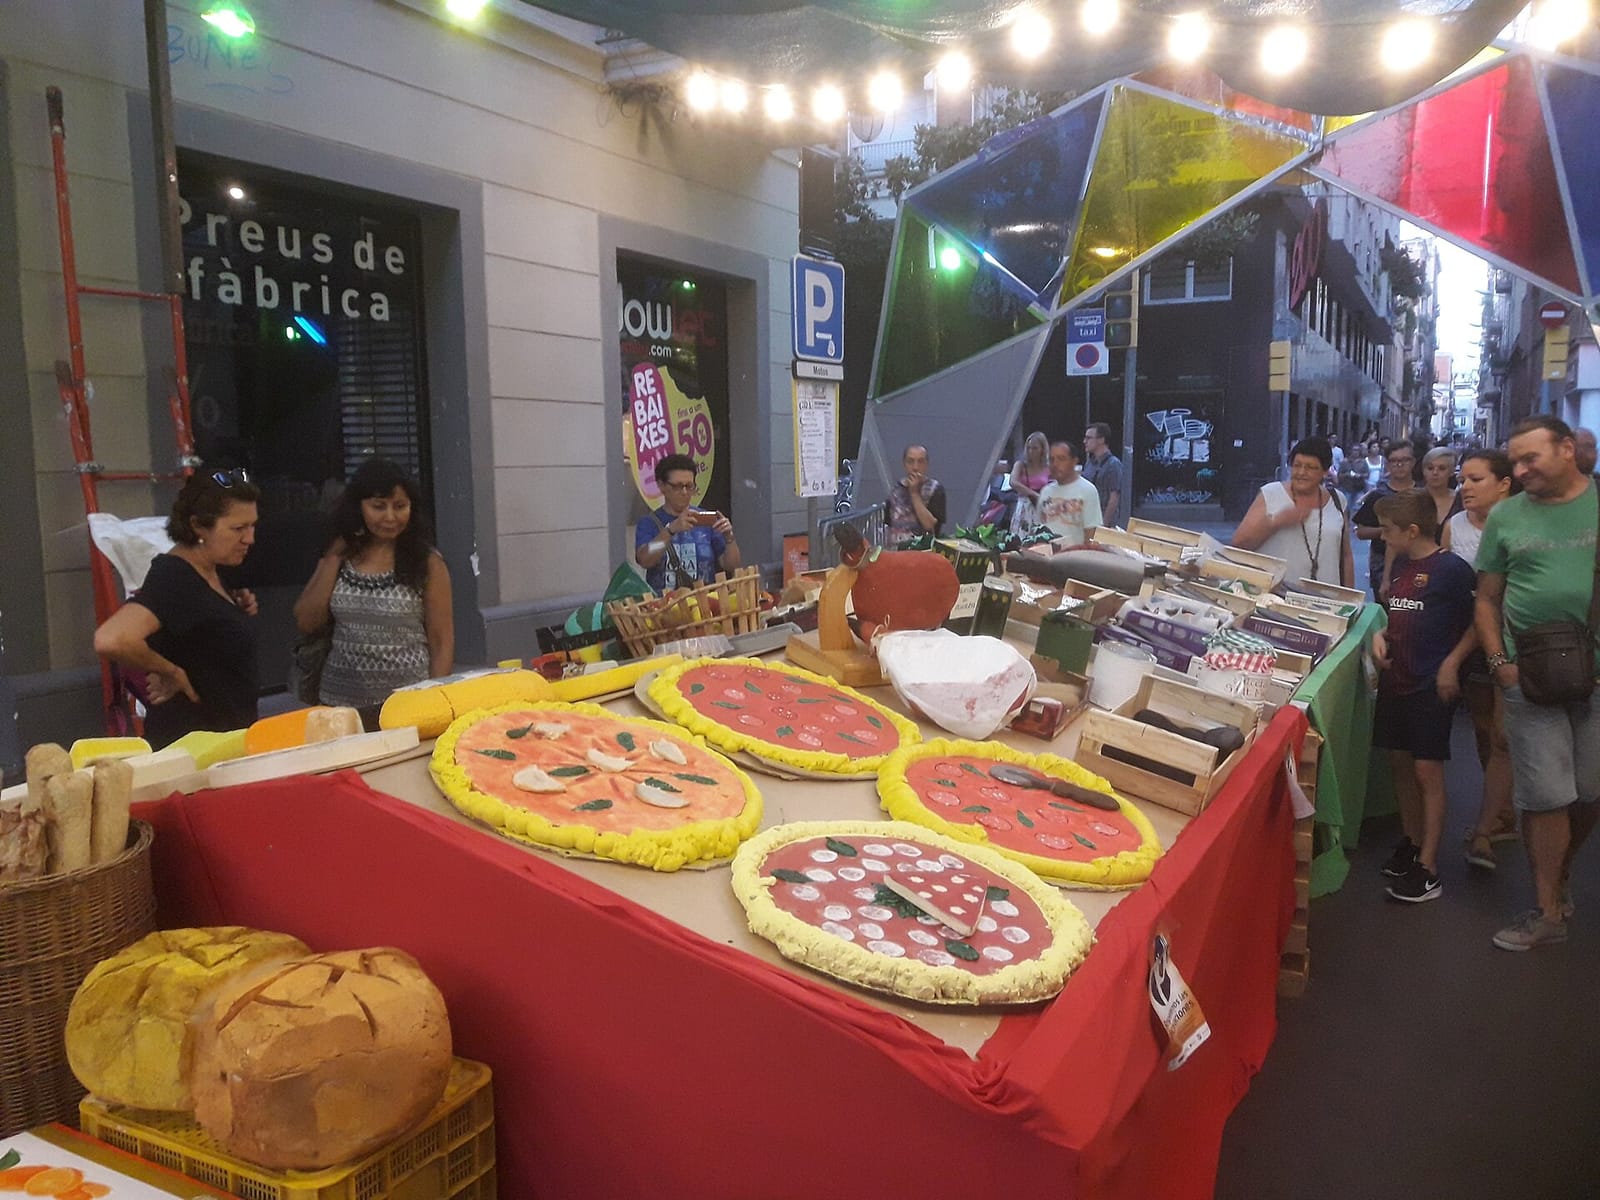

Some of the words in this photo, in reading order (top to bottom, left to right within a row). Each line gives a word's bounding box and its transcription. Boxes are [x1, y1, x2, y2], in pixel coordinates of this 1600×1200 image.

[353, 232, 406, 275] de
[187, 256, 390, 322] fàbrica
[618, 284, 672, 341] ow
[805, 268, 834, 347] P
[1079, 326, 1097, 337] taxi
[648, 344, 672, 358] .com
[634, 369, 656, 398] RE
[635, 394, 663, 425] BAI
[638, 420, 668, 451] XES
[677, 412, 712, 460] 50
[695, 461, 709, 475] te.
